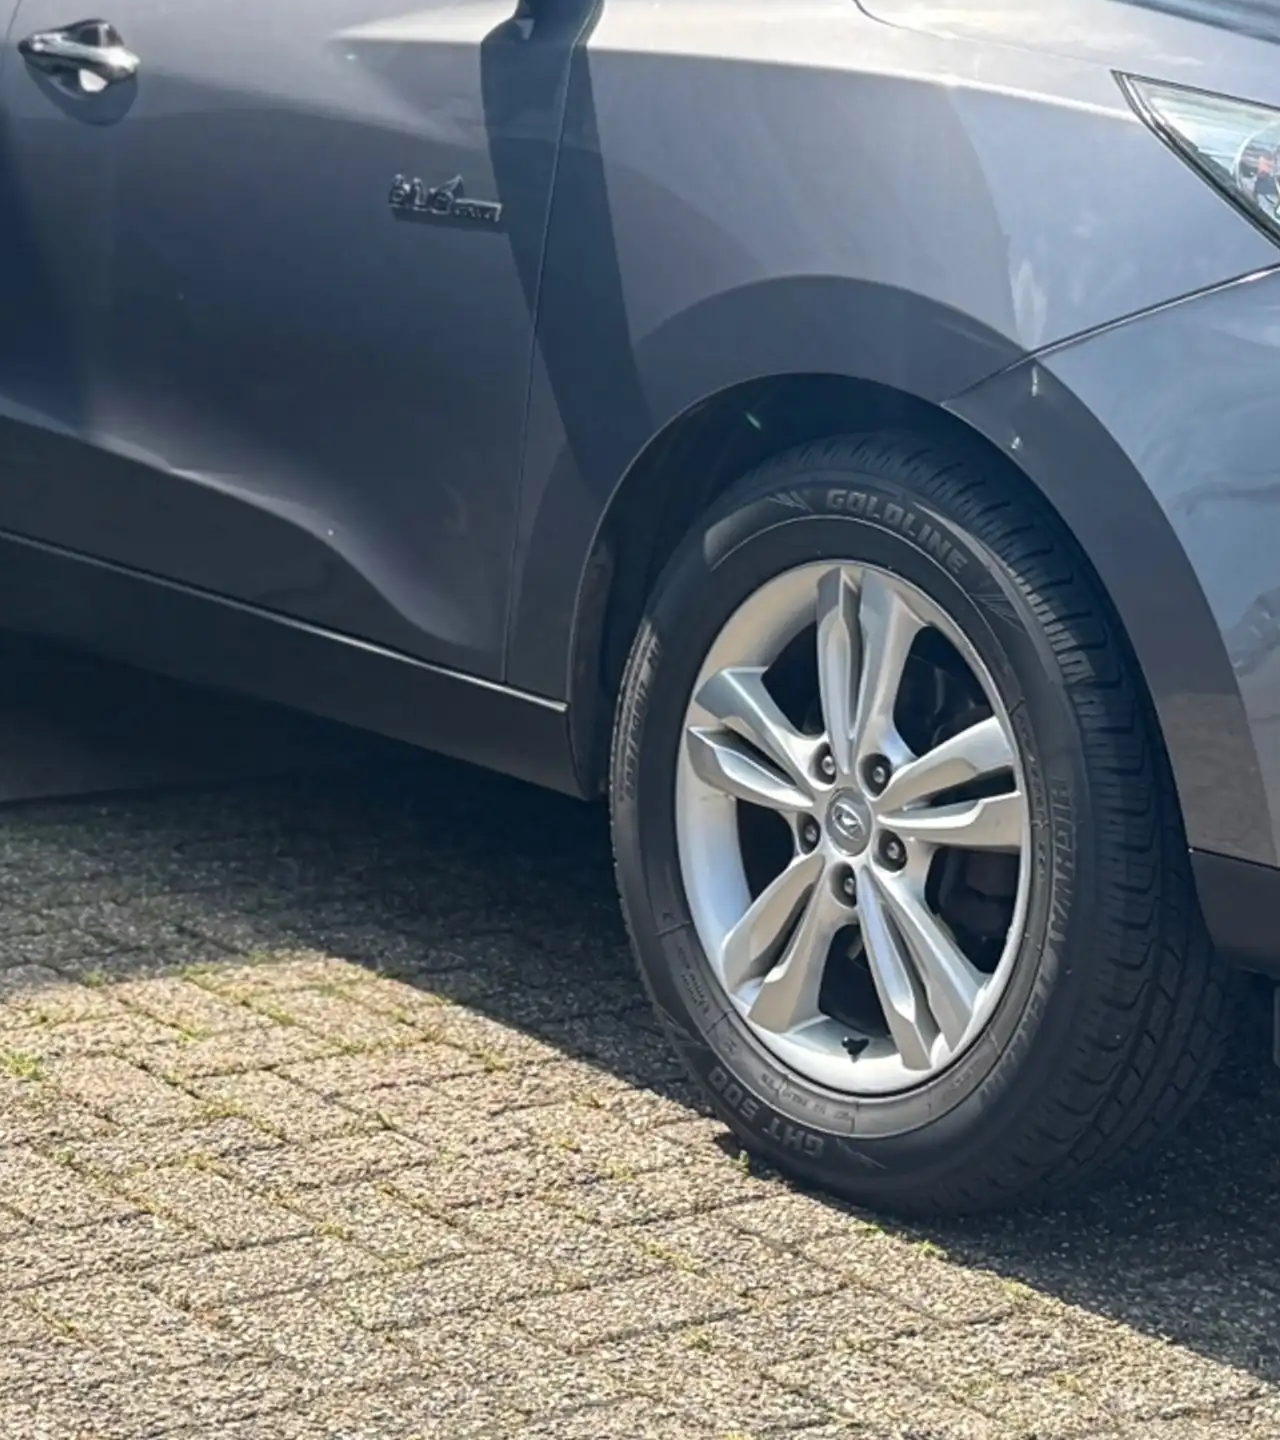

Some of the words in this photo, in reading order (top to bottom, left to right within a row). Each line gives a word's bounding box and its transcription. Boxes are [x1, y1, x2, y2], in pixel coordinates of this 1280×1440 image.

[824, 488, 969, 575] GOLDLINE
[707, 1065, 760, 1121] 500
[762, 1117, 825, 1158] GHT
